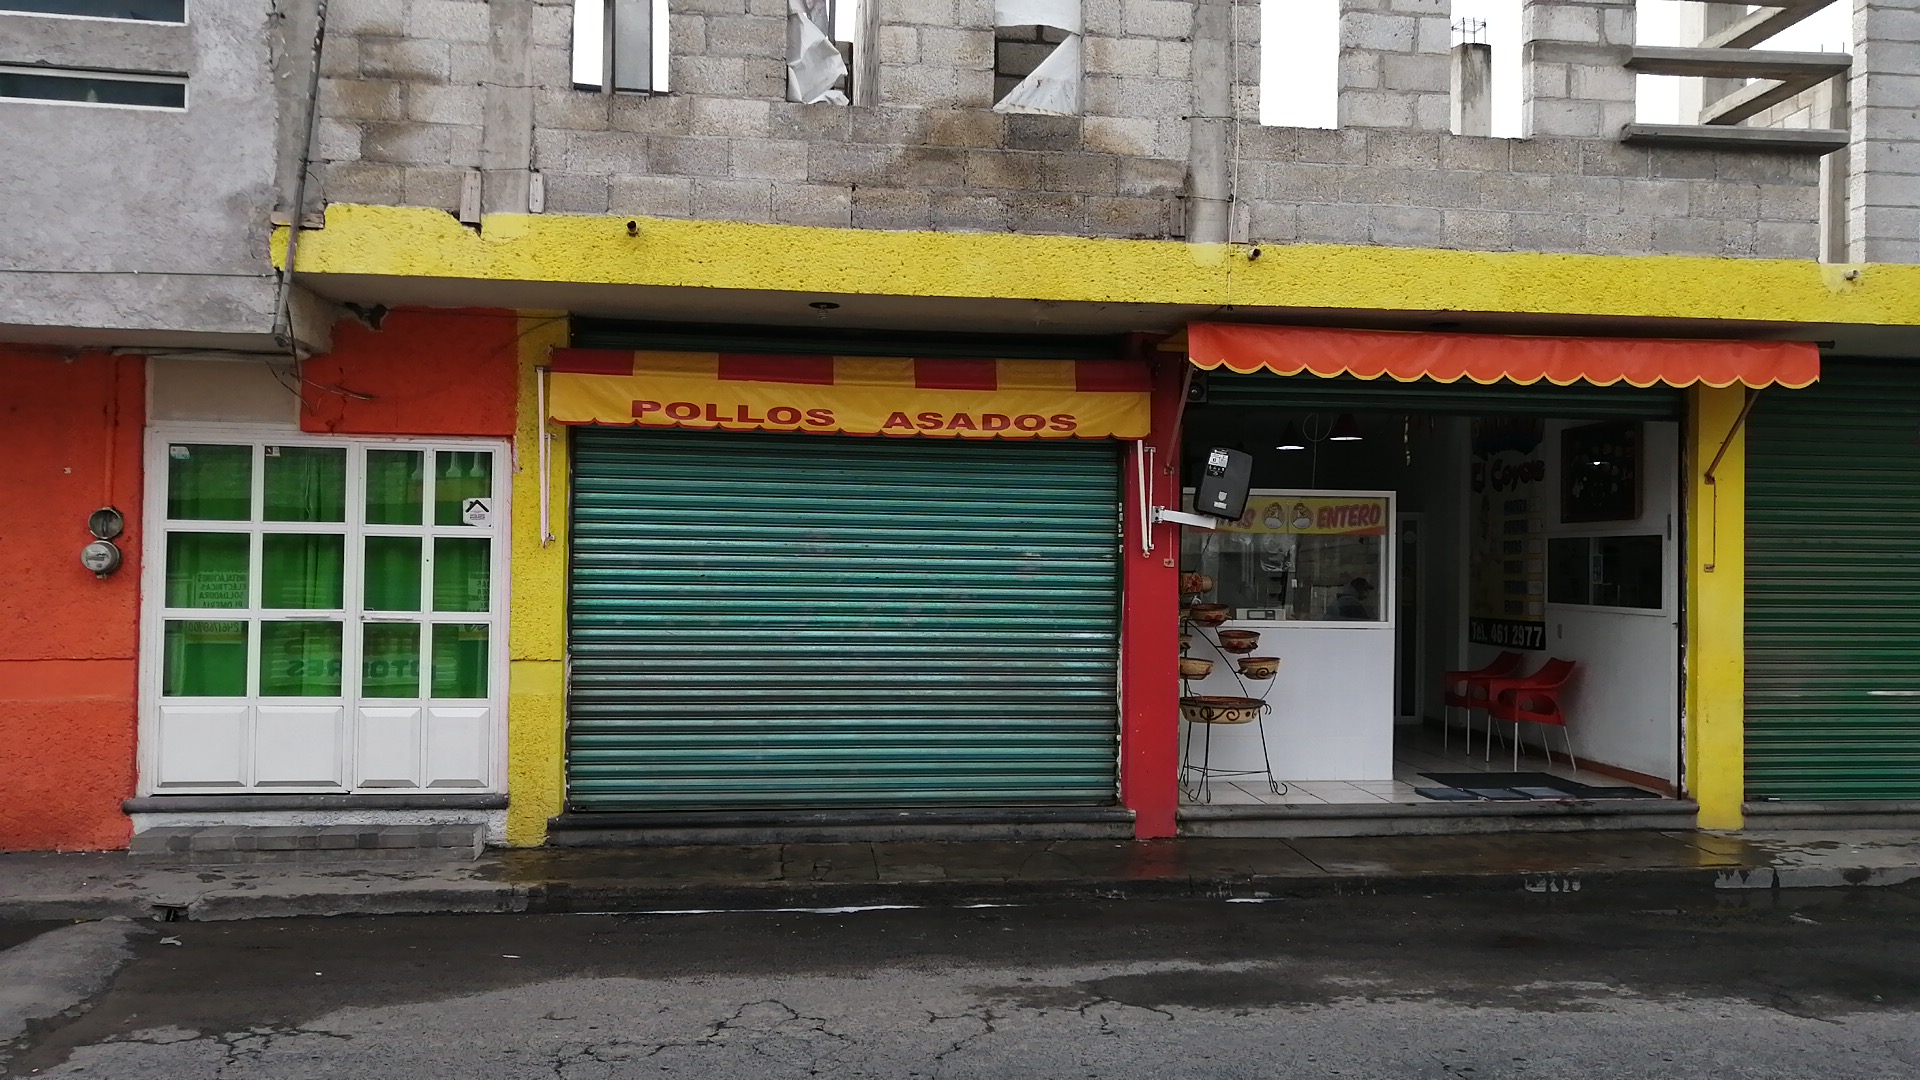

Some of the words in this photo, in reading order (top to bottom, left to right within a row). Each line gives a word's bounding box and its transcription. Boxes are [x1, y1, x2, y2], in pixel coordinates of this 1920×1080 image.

[631, 399, 835, 427] POLLOS
[884, 409, 1079, 432] ASADOS
[1317, 503, 1382, 529] ENTERO
[1471, 622, 1488, 641] Tel.
[1491, 624, 1508, 644] 461
[1511, 625, 1542, 647] 2977
